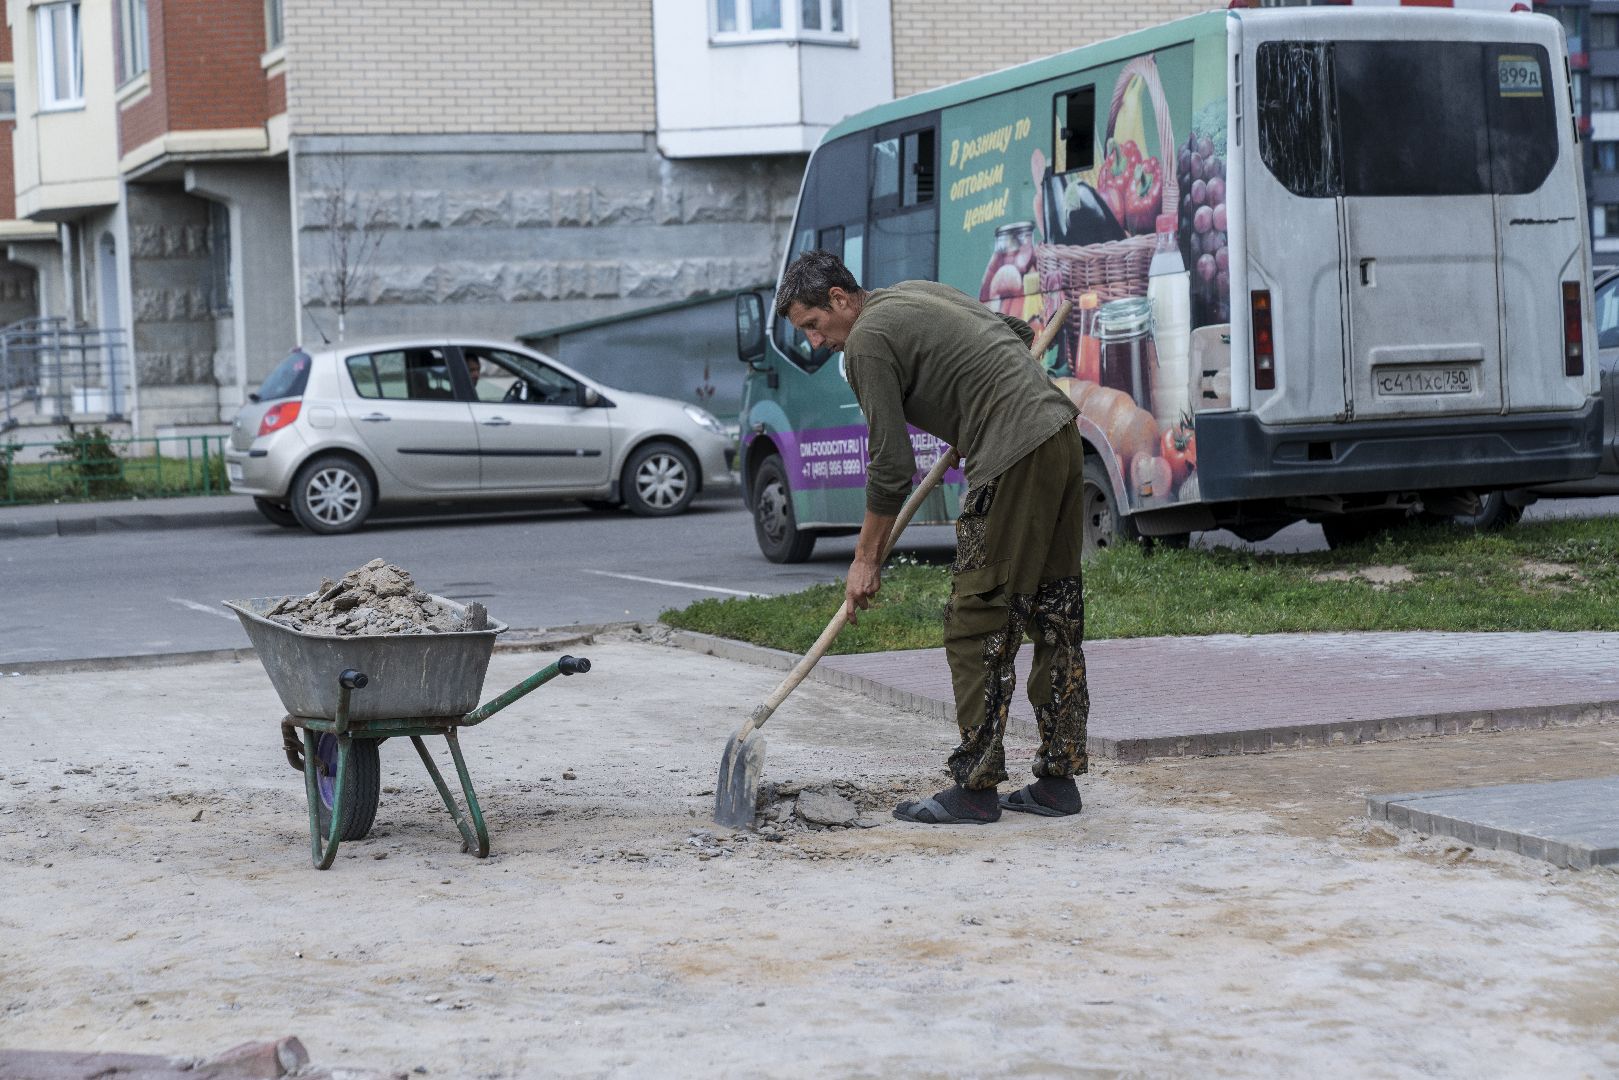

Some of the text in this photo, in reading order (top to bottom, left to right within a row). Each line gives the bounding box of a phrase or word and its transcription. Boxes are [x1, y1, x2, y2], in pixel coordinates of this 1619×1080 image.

[949, 117, 1030, 170] В розницу по
[949, 163, 1005, 201] оптовым
[963, 187, 1009, 232] ценам!
[1445, 371, 1465, 384] 750
